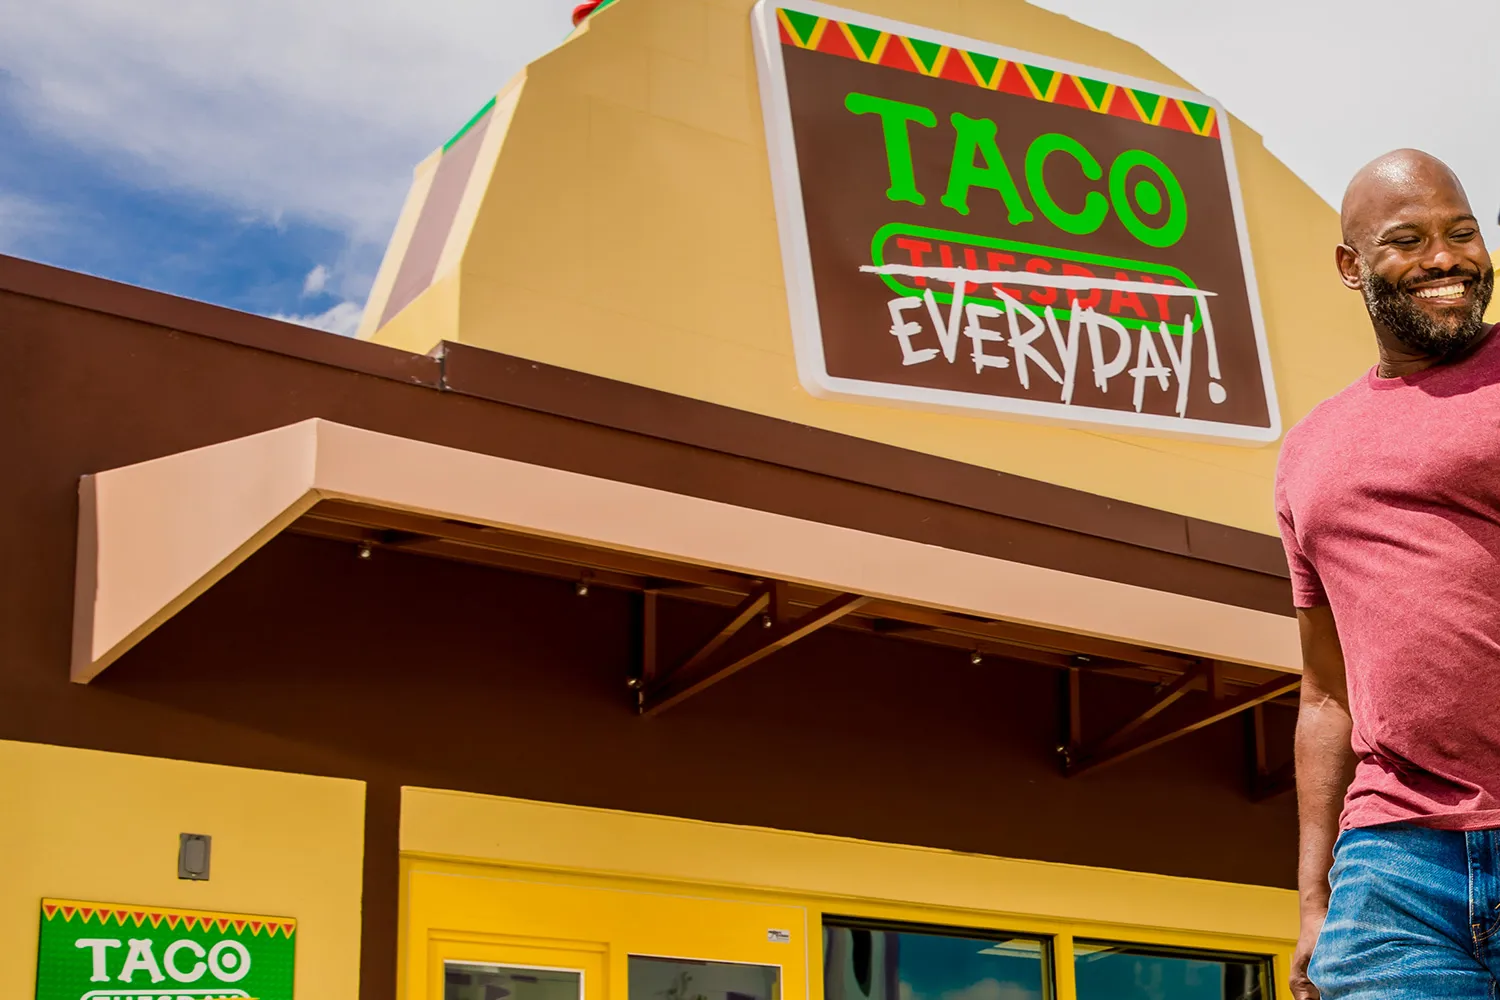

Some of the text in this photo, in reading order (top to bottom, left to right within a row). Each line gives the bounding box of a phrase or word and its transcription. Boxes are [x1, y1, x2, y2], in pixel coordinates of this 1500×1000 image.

[845, 92, 1187, 248] TACO
[896, 237, 1175, 320] TUESDAY
[887, 272, 1227, 418] EVERYDAY!
[74, 938, 251, 983] TACO
